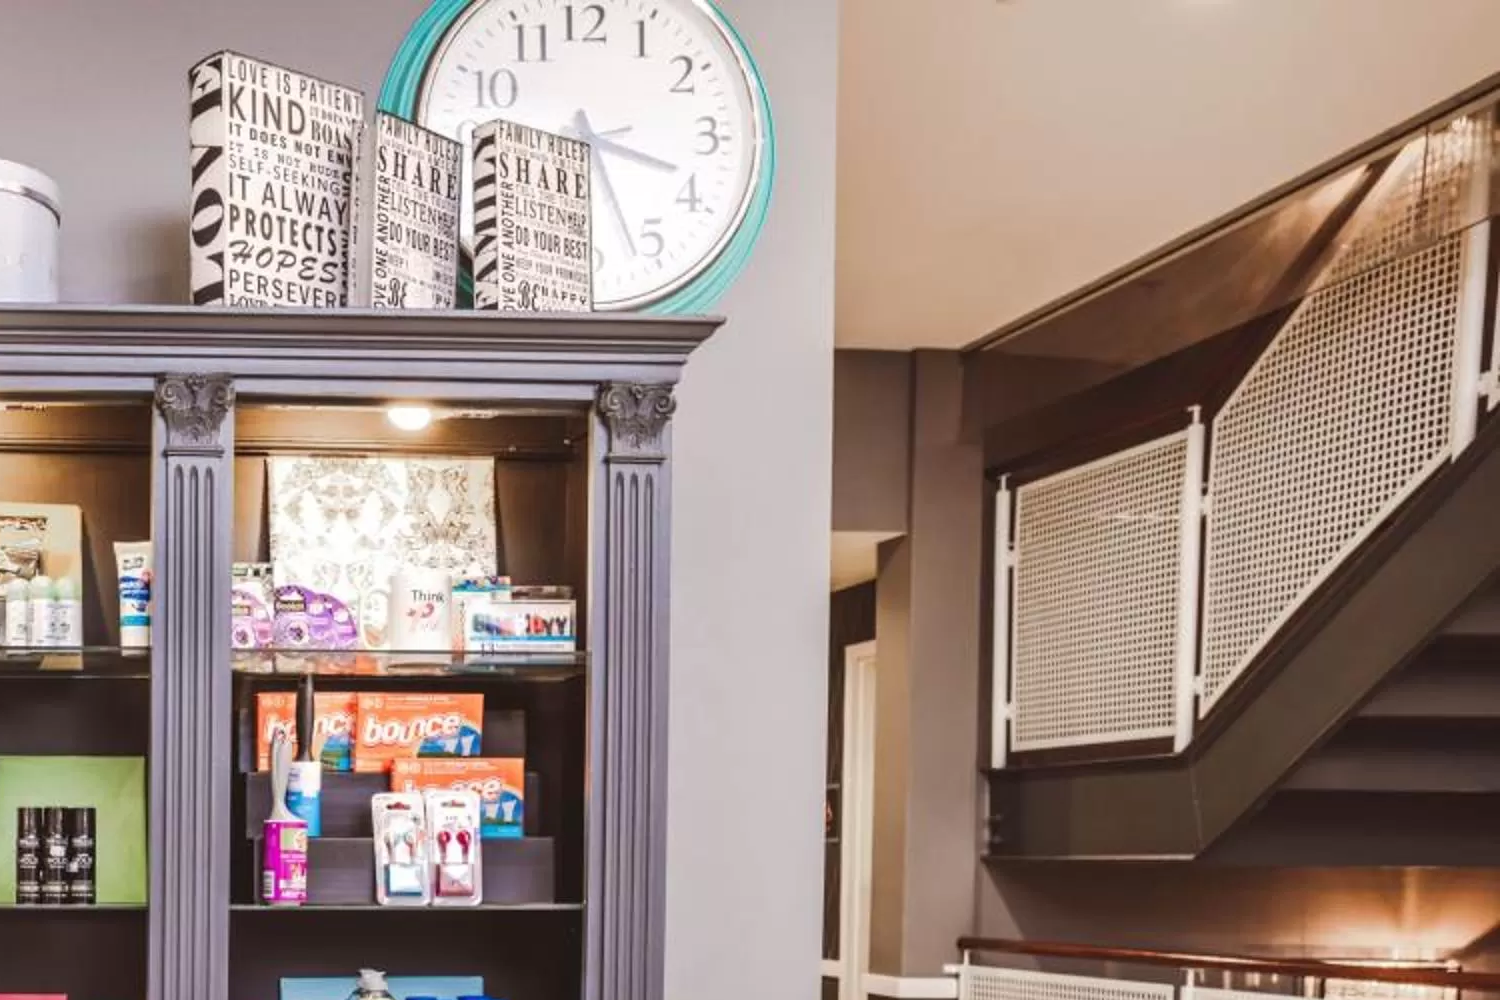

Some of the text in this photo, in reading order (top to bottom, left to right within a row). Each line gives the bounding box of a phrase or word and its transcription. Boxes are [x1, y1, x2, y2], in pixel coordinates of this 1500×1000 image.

[512, 24, 556, 62] 11
[563, 4, 607, 44] 12
[632, 19, 649, 58] 1
[228, 54, 361, 116] LOVE IS PATIENT
[472, 68, 518, 109] 10
[668, 55, 695, 95] 2
[228, 82, 306, 136] KIND
[229, 121, 242, 137] IT
[250, 127, 287, 149] DOES
[295, 141, 321, 159] NOT
[500, 122, 541, 150] FAMILY
[548, 133, 584, 163] RULES
[696, 116, 721, 156] 3
[228, 153, 342, 197] SELF-SEEKING
[277, 153, 301, 168] NOT
[377, 145, 457, 201] SHARE
[499, 151, 587, 199] SHARE
[229, 171, 251, 201] IT
[676, 173, 702, 213] 4
[390, 191, 437, 226] LISTEN
[515, 195, 567, 226] LISTEN
[228, 203, 338, 257] PROTECTS
[373, 175, 391, 308] OVE ONE ANOTHER
[405, 226, 431, 254] YOUR
[433, 236, 455, 261] BEST
[501, 181, 516, 310] OVE ONE ANOTHER
[533, 229, 561, 255] YOUR
[563, 237, 588, 262] BEST
[639, 217, 665, 258] 5
[228, 239, 339, 284] HOPES
[363, 711, 460, 747] bounce
